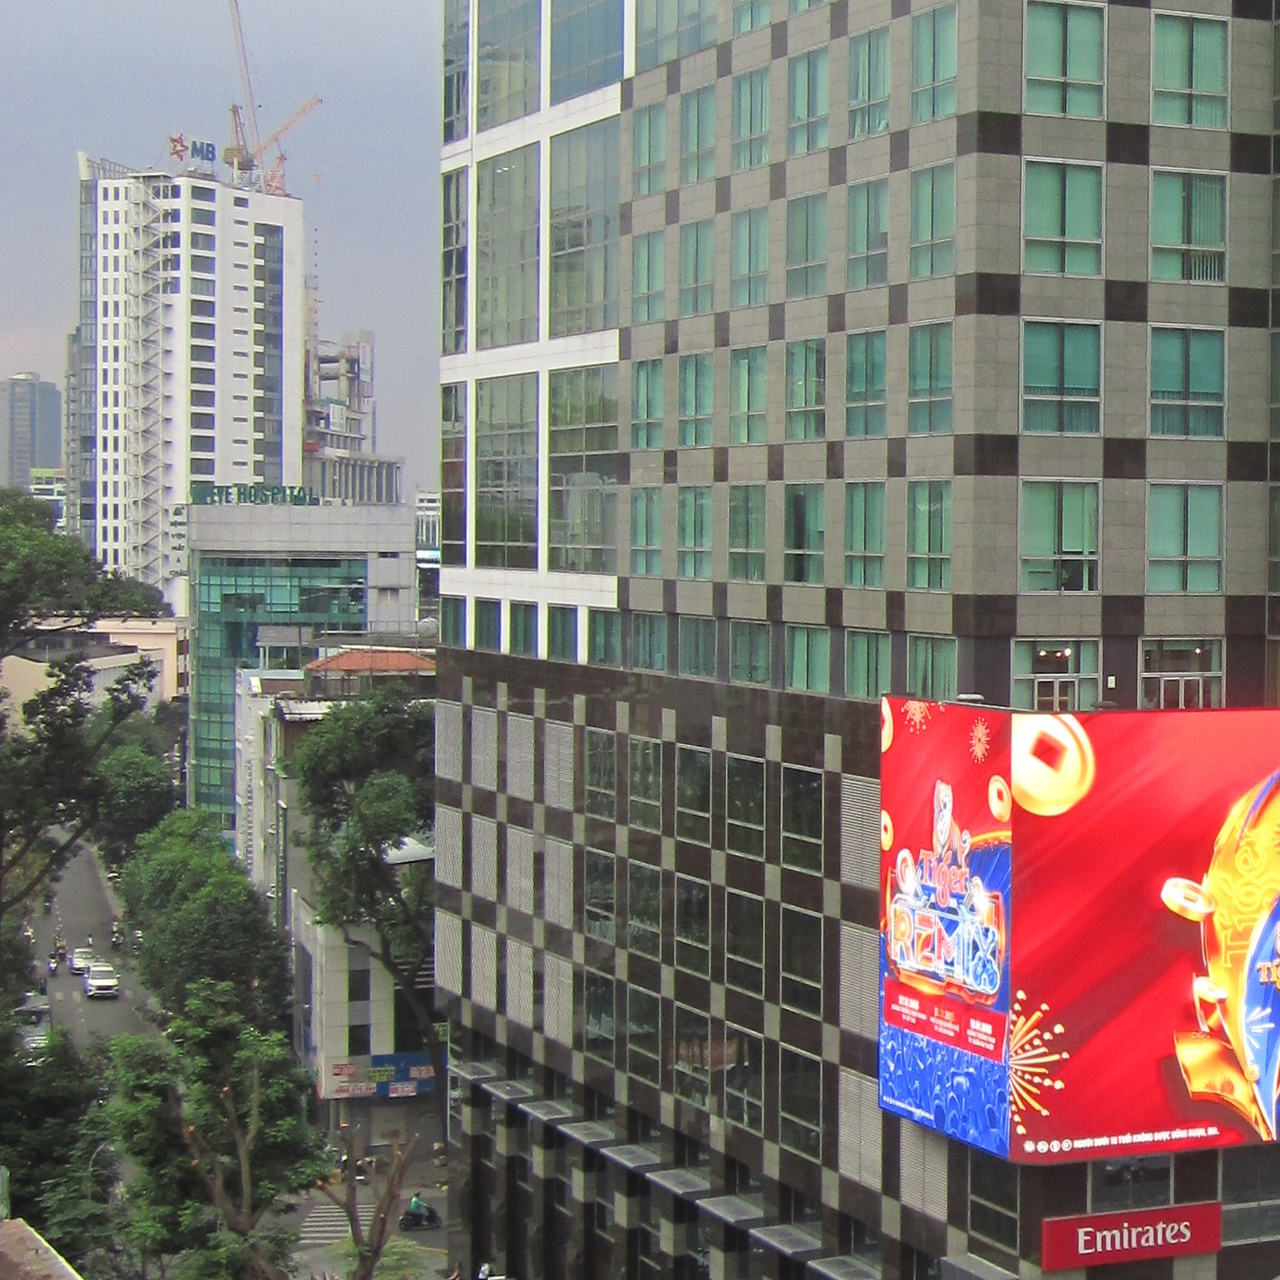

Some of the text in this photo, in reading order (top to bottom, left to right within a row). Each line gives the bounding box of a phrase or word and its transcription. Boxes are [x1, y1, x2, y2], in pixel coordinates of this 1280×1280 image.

[191, 140, 216, 162] MB
[236, 484, 321, 506] HOSPITAL
[919, 848, 970, 908] Tiger
[890, 903, 1001, 995] REMIX
[1077, 1220, 1192, 1255] Emirates
